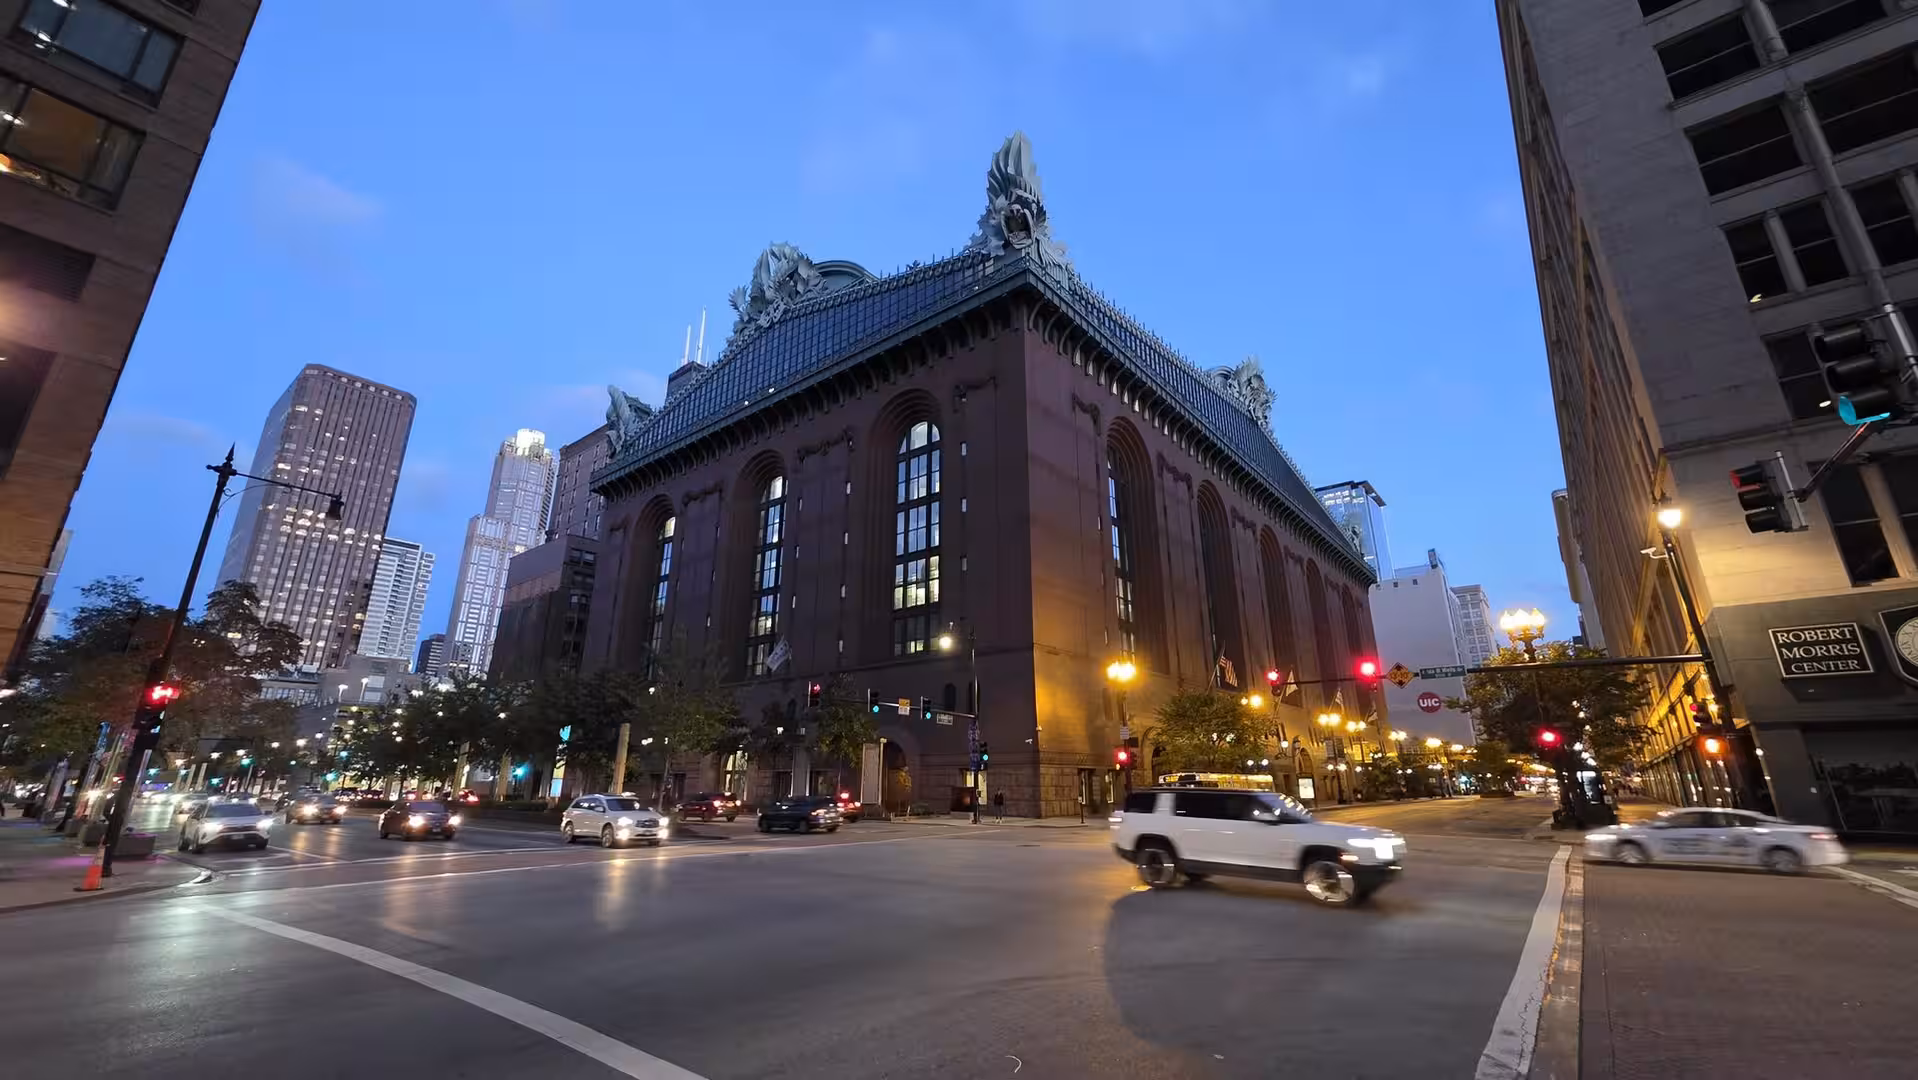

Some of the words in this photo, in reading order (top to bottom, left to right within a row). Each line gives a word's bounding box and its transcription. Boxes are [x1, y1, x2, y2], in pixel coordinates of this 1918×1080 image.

[1775, 627, 1853, 644] ROBERT
[1780, 643, 1861, 659] MORRIS
[1791, 659, 1861, 673] CENTER
[1419, 698, 1440, 707] UIC
